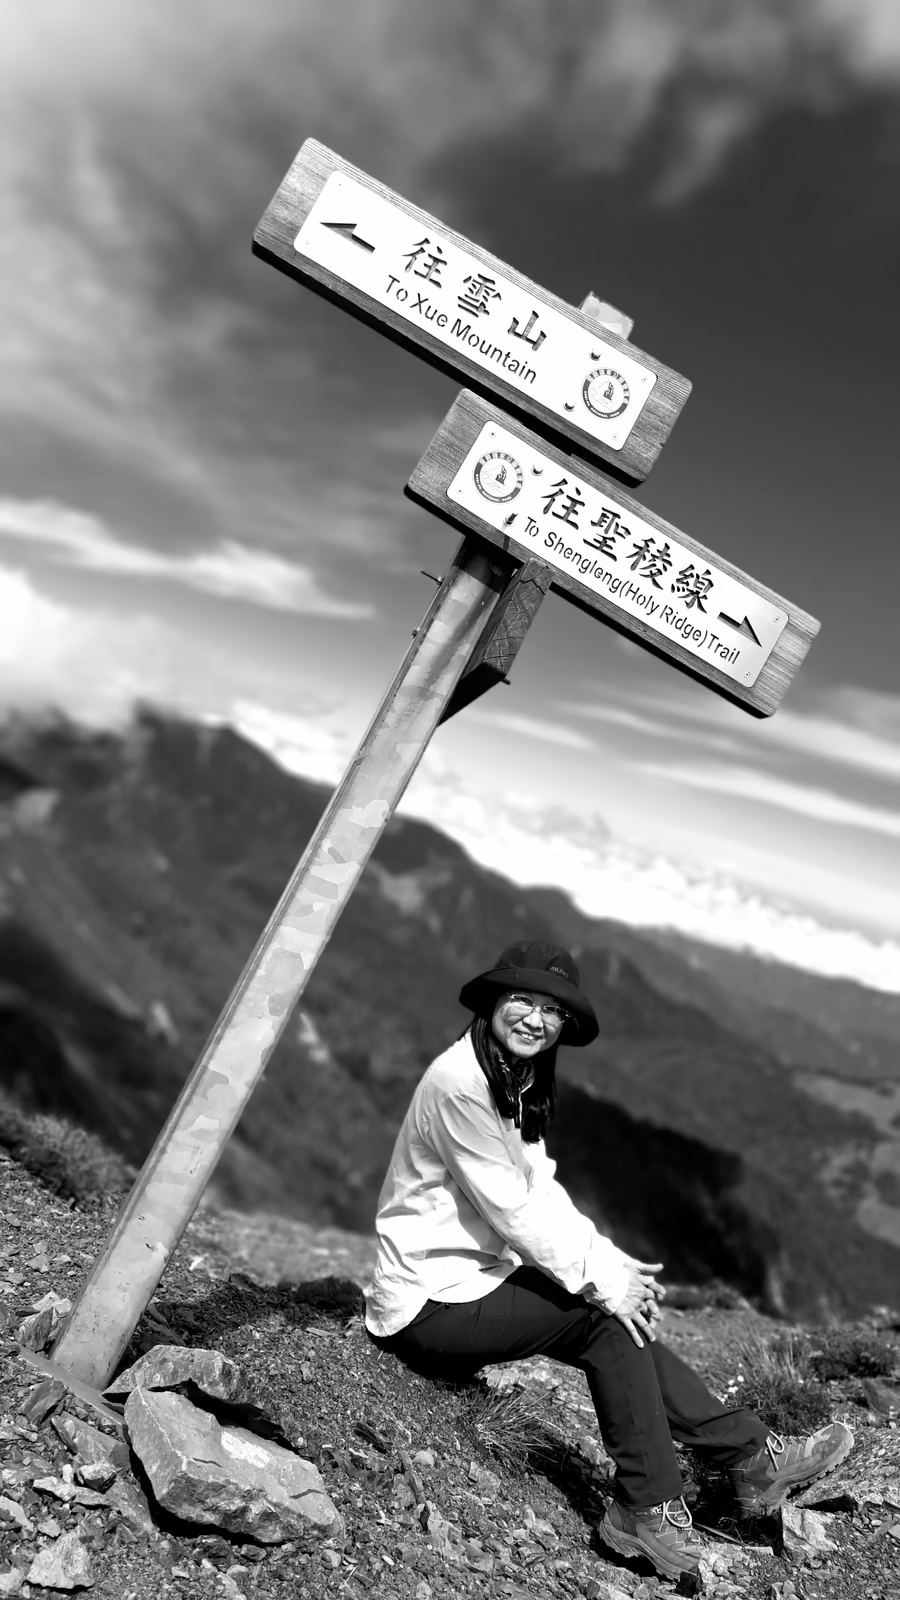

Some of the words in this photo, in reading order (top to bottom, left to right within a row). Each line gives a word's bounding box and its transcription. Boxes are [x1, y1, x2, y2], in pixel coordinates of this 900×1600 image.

[385, 275, 408, 301] To
[410, 293, 449, 328] Xue
[450, 318, 537, 384] Mountain
[402, 237, 547, 351] 往雪山
[523, 517, 540, 538] To
[541, 478, 715, 613] 往聖稜線
